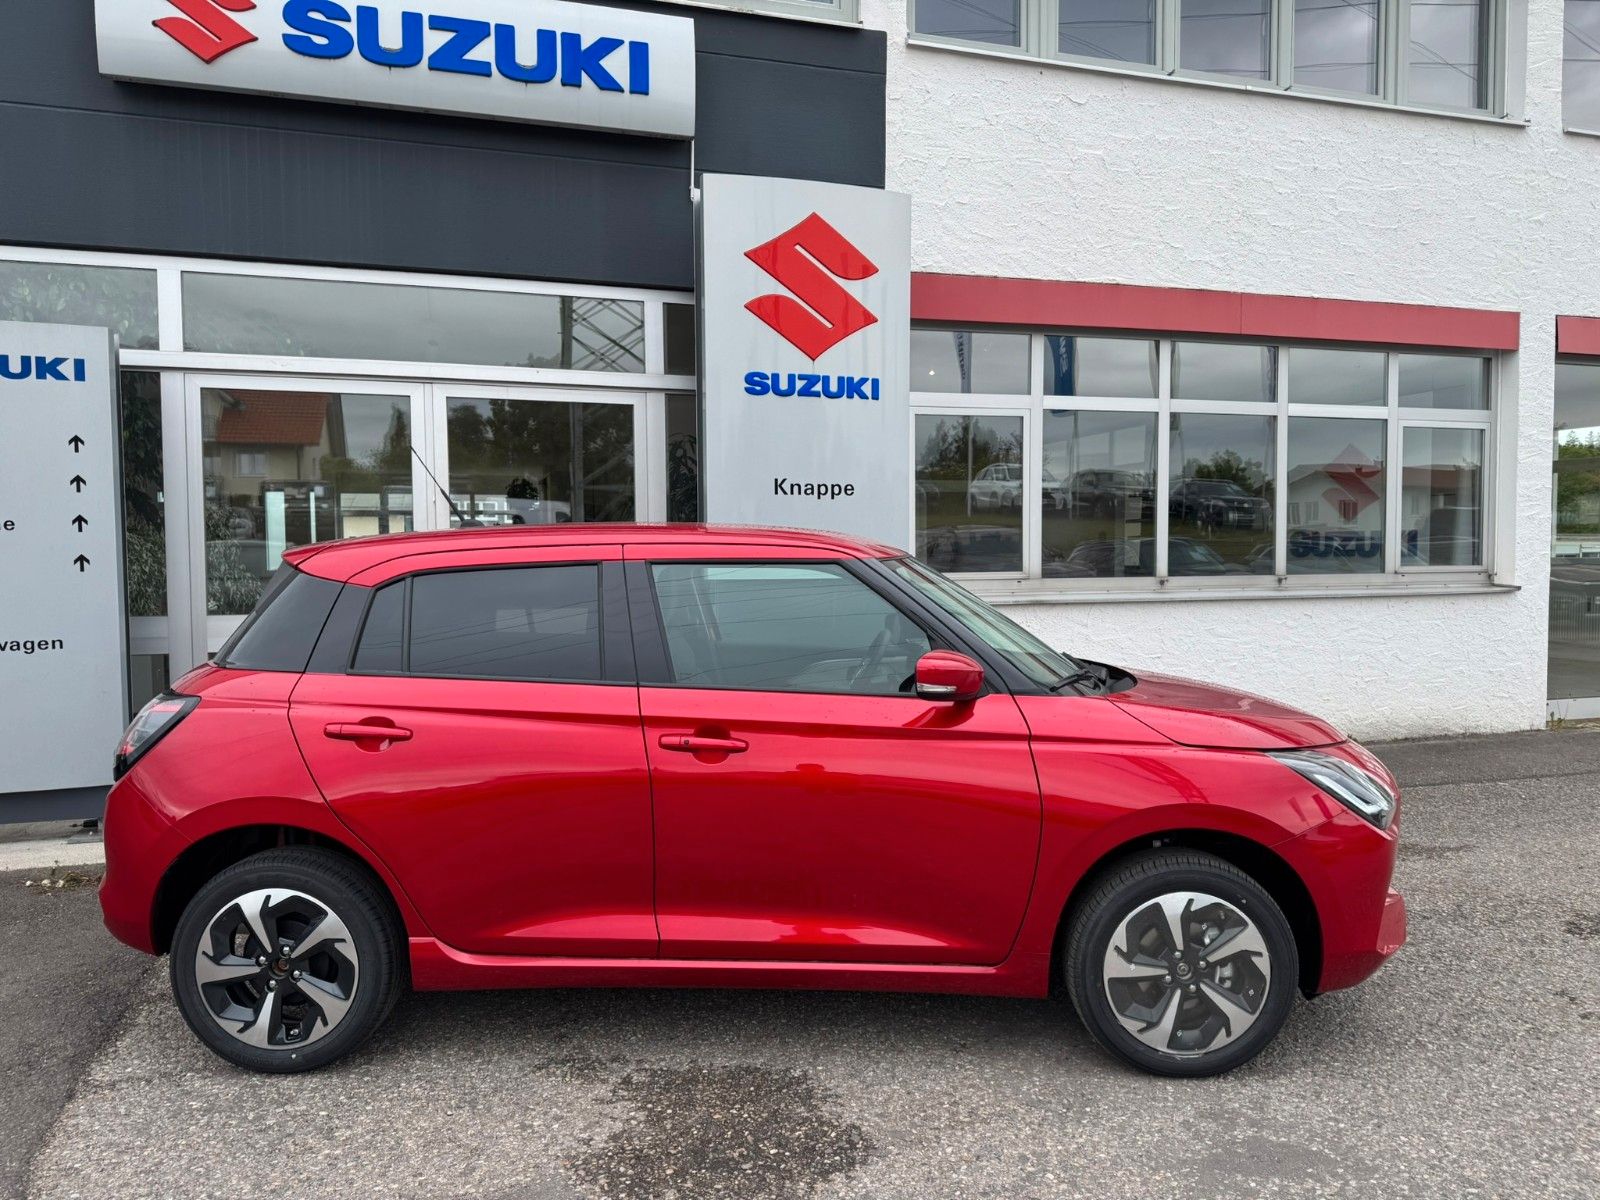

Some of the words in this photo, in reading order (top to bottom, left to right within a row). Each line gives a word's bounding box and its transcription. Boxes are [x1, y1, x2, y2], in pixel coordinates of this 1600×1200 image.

[282, 0, 650, 96] SUZUKI
[743, 371, 880, 401] SUZUKI
[773, 477, 855, 500] Knappe
